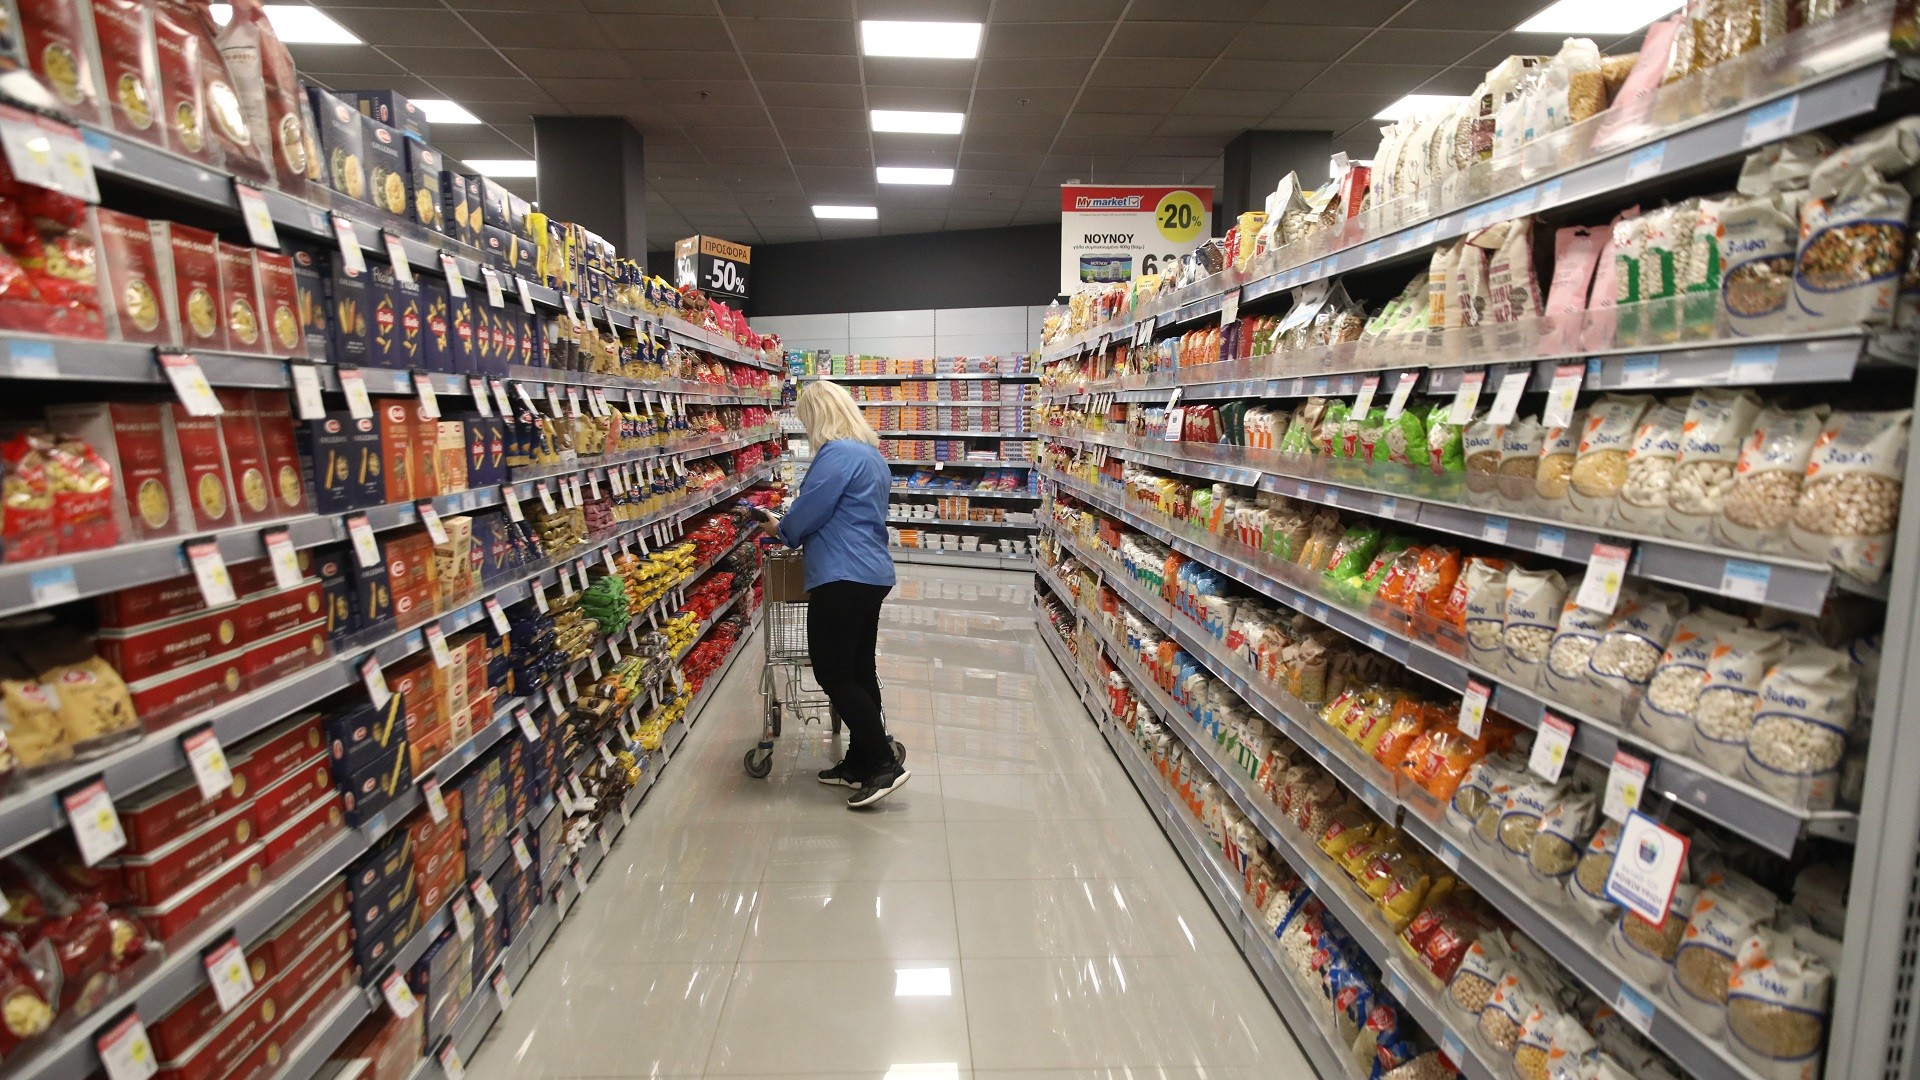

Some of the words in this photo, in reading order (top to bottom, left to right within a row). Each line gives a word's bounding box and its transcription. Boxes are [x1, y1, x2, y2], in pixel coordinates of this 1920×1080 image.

[1077, 197, 1092, 208] My
[1092, 196, 1127, 206] market
[1158, 203, 1202, 229] -20%
[705, 240, 748, 260] ΠΡΟΣΦΟΡΑ
[705, 258, 745, 293] -50%
